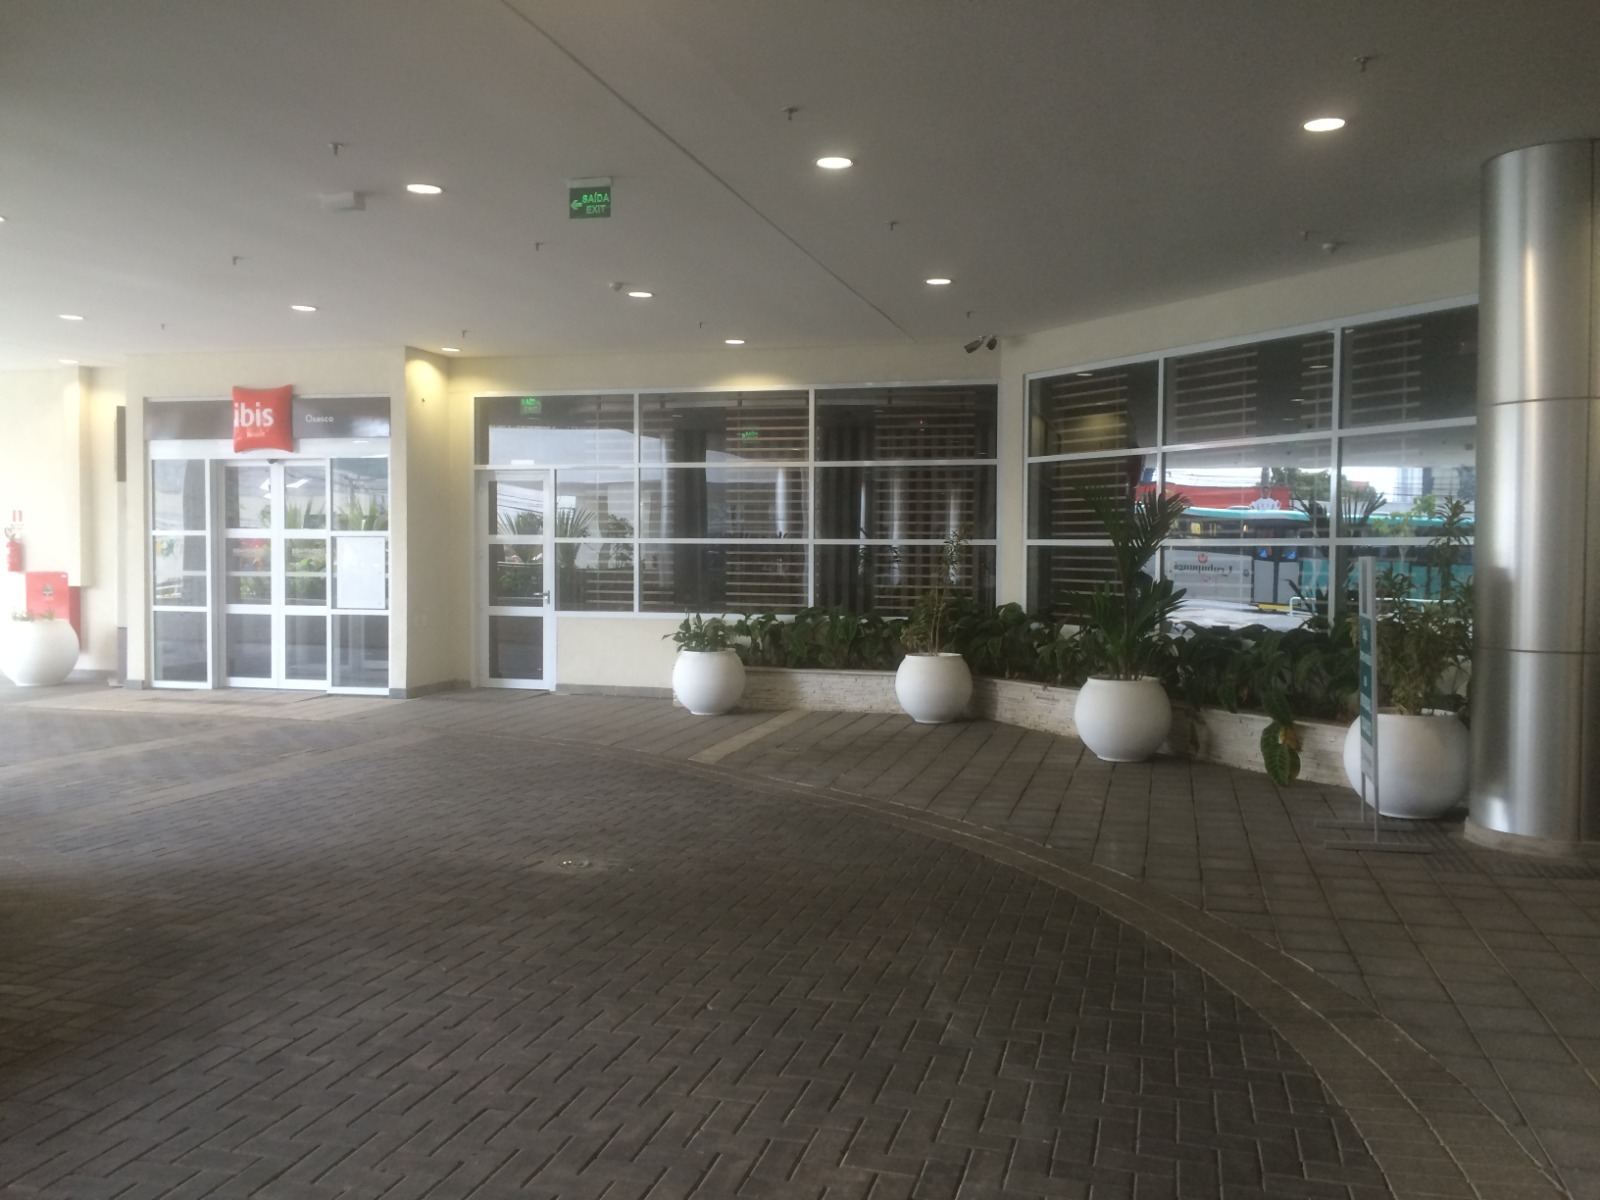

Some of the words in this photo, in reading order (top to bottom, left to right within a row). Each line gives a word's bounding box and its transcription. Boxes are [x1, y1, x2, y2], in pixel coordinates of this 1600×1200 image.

[582, 192, 609, 203] SAÍDA
[586, 205, 606, 214] EXIT
[233, 401, 274, 428] ibis
[305, 415, 334, 423] Osasco
